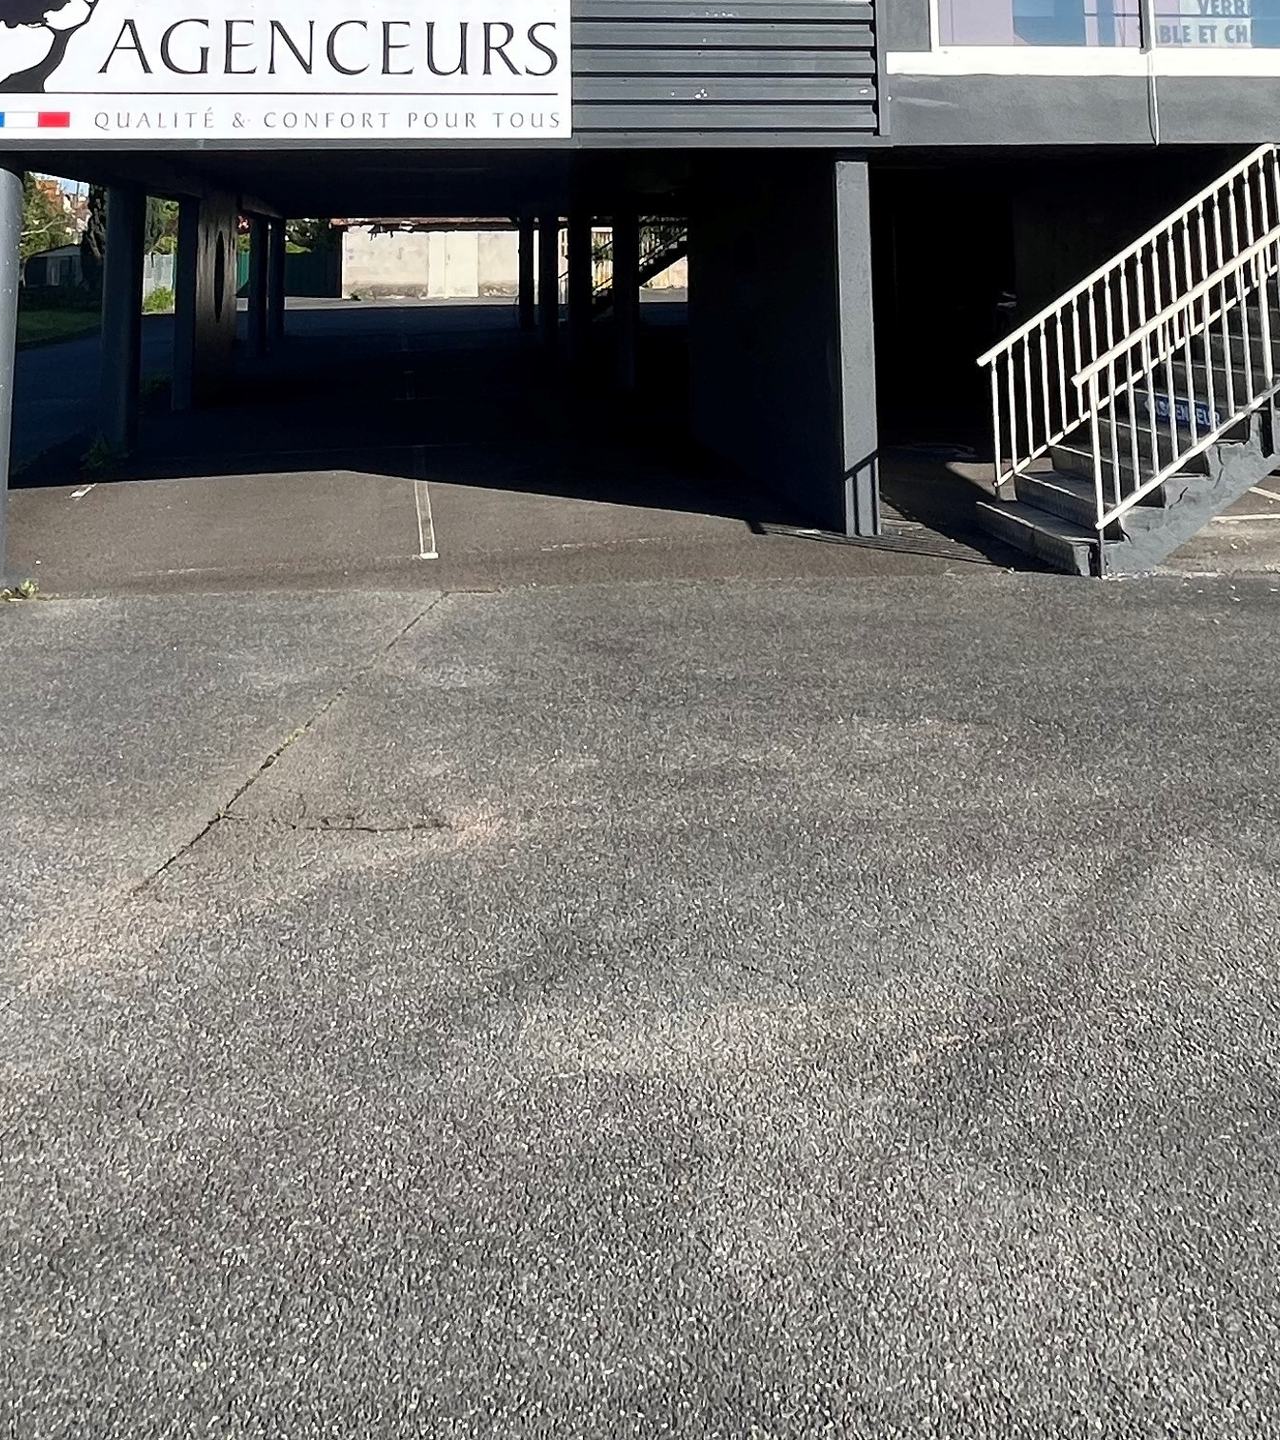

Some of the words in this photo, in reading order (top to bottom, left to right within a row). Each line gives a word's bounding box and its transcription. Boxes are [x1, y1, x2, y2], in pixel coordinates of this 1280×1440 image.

[96, 18, 558, 78] AGENCEURS
[93, 107, 215, 131] QUALITÉ
[231, 111, 252, 130] &
[264, 110, 391, 130] CONFORT
[408, 111, 477, 130] POUR
[493, 111, 561, 130] TOUS
